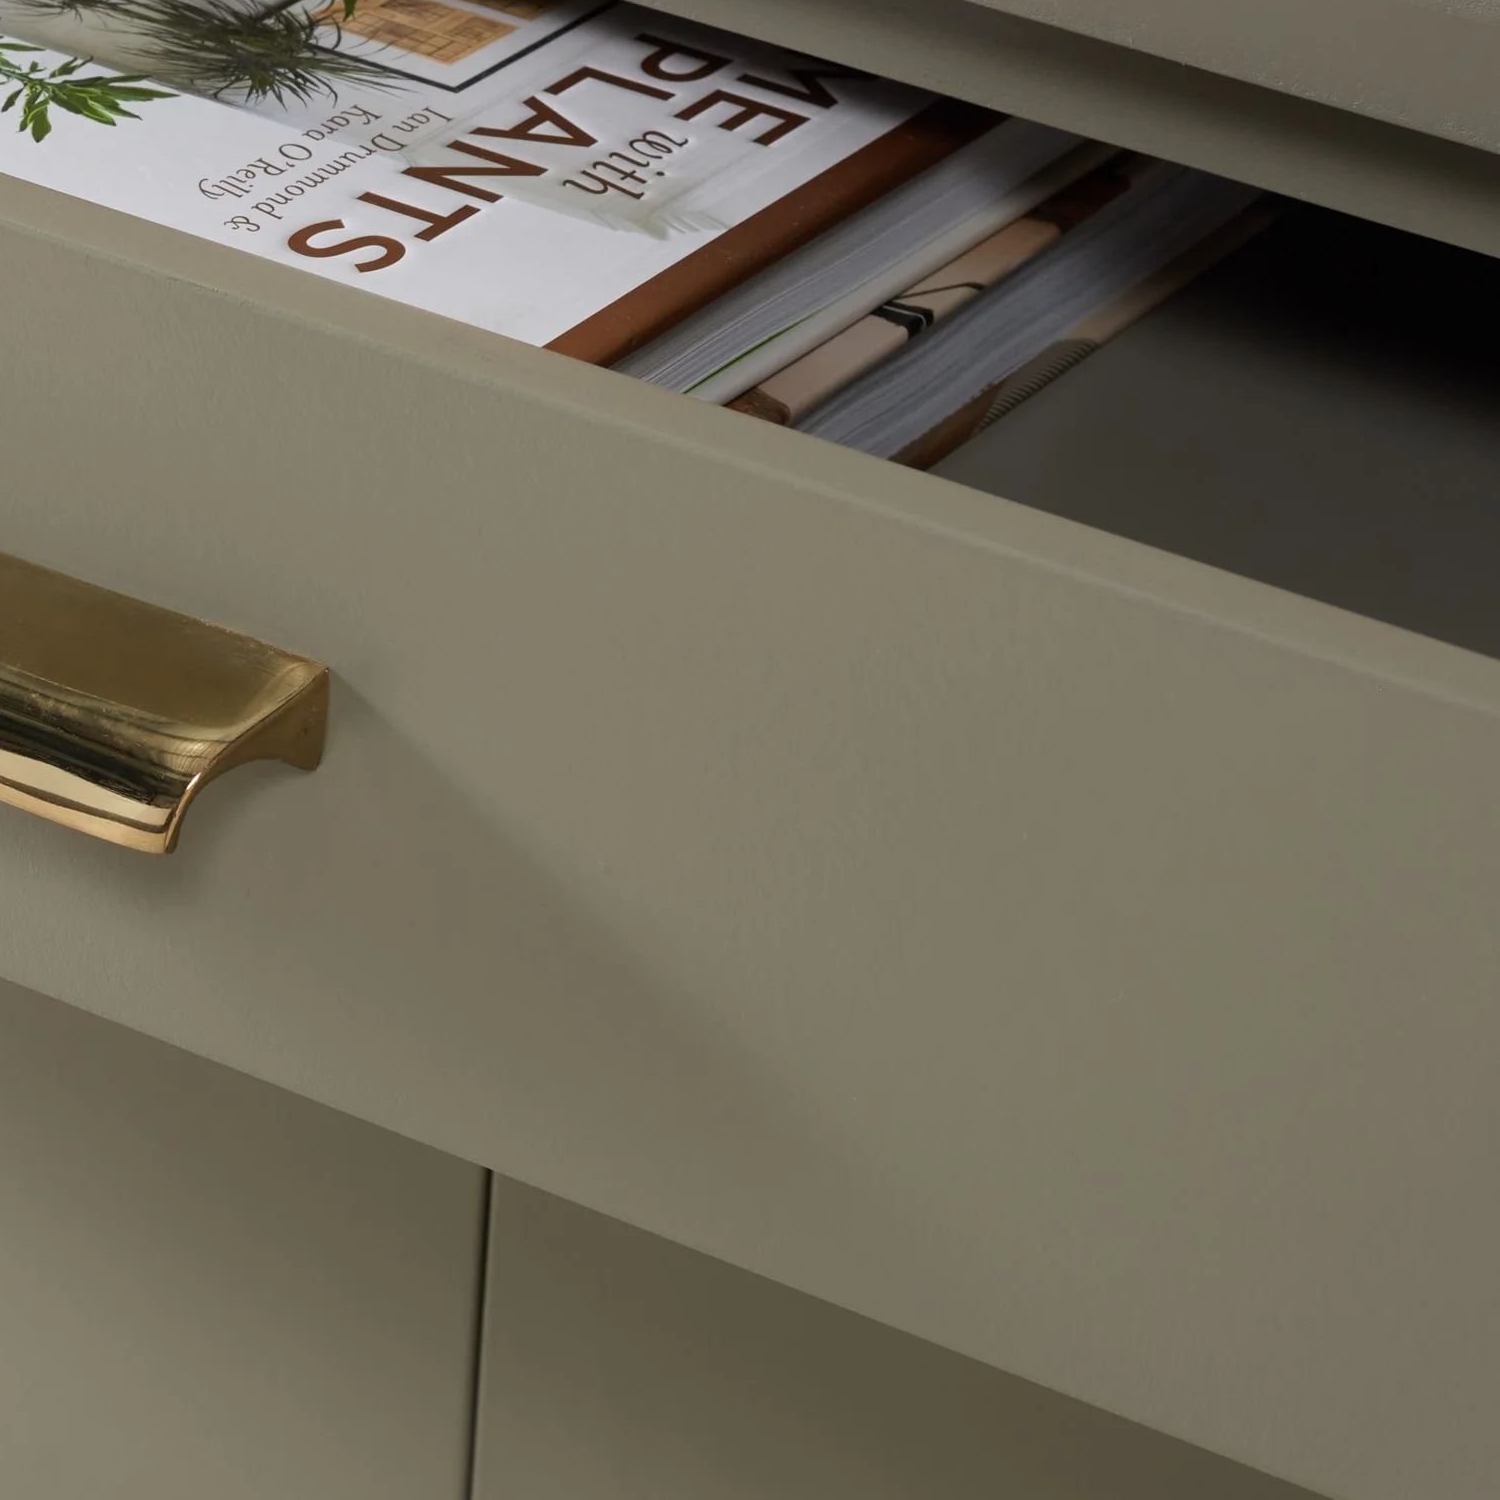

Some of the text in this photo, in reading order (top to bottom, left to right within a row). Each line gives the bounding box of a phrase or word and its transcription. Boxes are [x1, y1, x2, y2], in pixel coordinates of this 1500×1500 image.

[198, 104, 383, 199] Kara O'Reilly
[224, 107, 453, 232] Ian Drummond &
[287, 32, 734, 273] PLANTS
[563, 130, 689, 200] with
